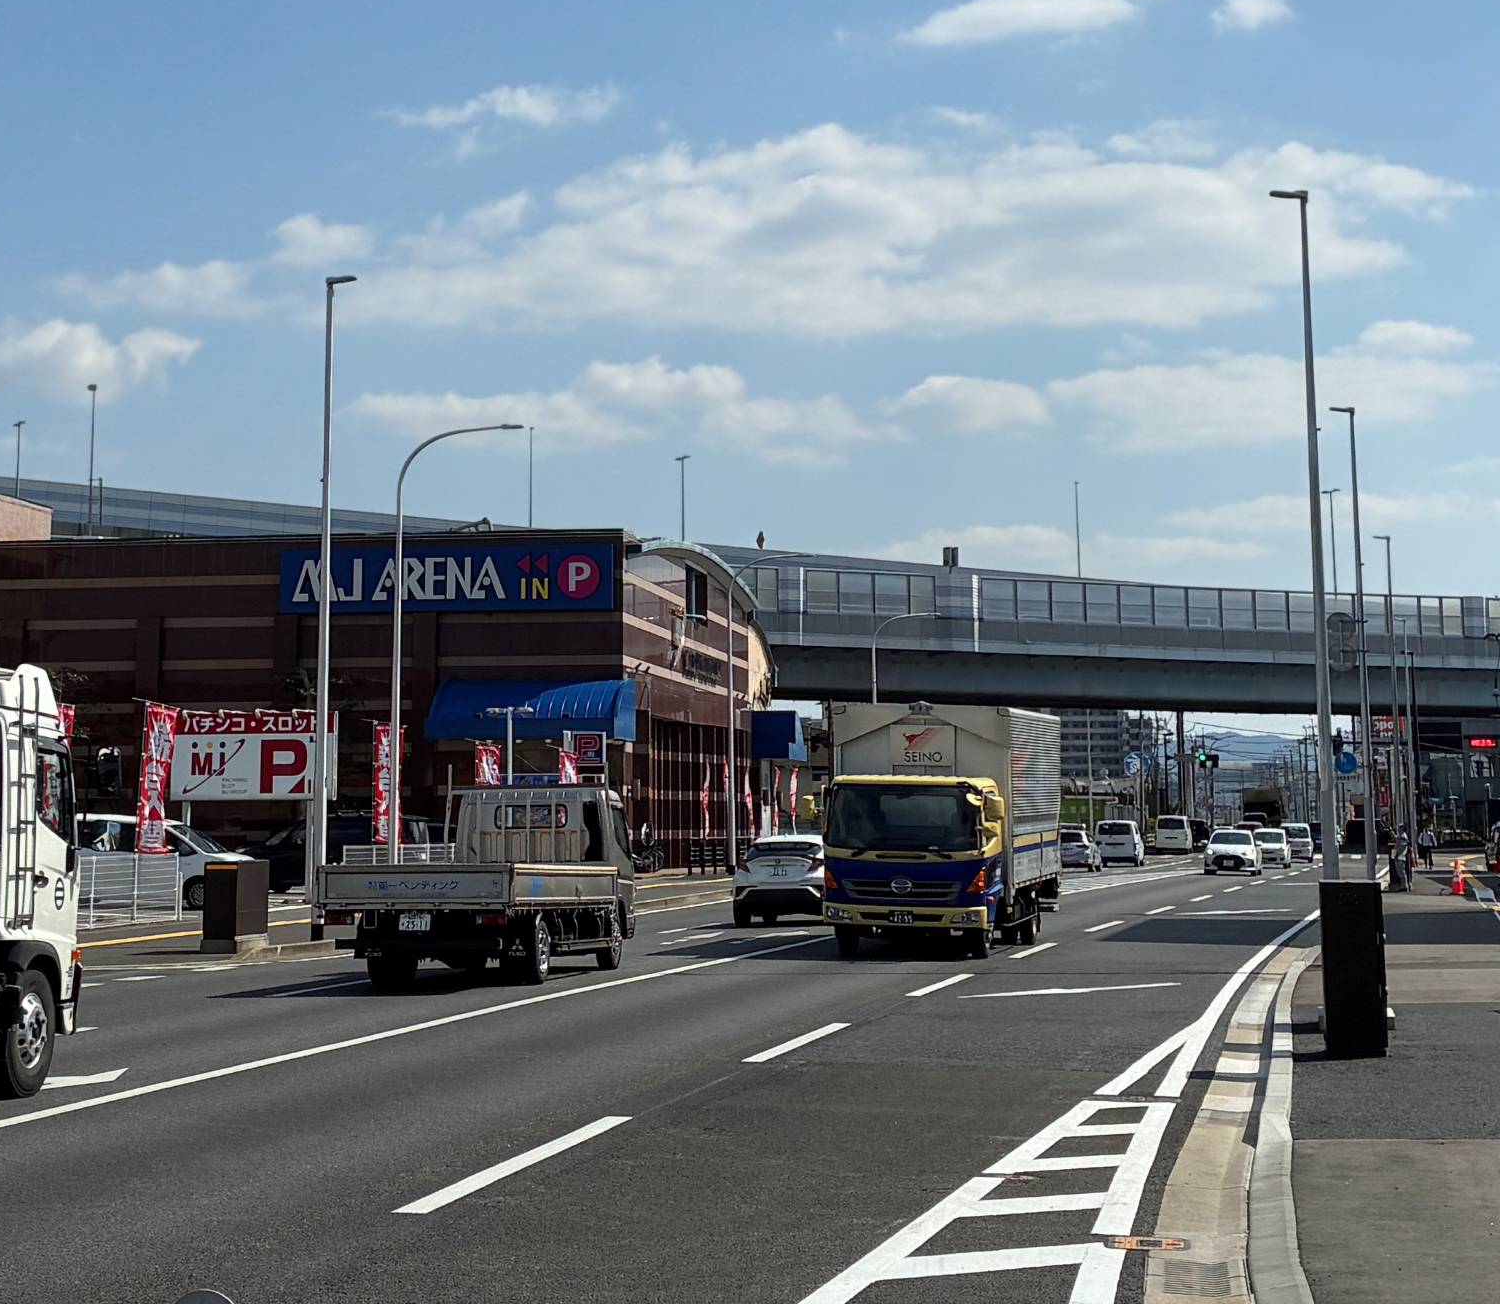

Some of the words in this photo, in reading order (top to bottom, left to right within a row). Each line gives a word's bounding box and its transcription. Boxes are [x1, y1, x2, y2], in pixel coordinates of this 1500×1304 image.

[292, 559, 363, 602] MJ
[371, 556, 506, 601] ARENA
[520, 577, 549, 600] IN
[567, 562, 591, 592] P
[183, 715, 318, 733] パチンコ・スロット
[191, 752, 225, 776] MJ
[260, 739, 308, 794] P
[904, 751, 943, 763] SEINO
